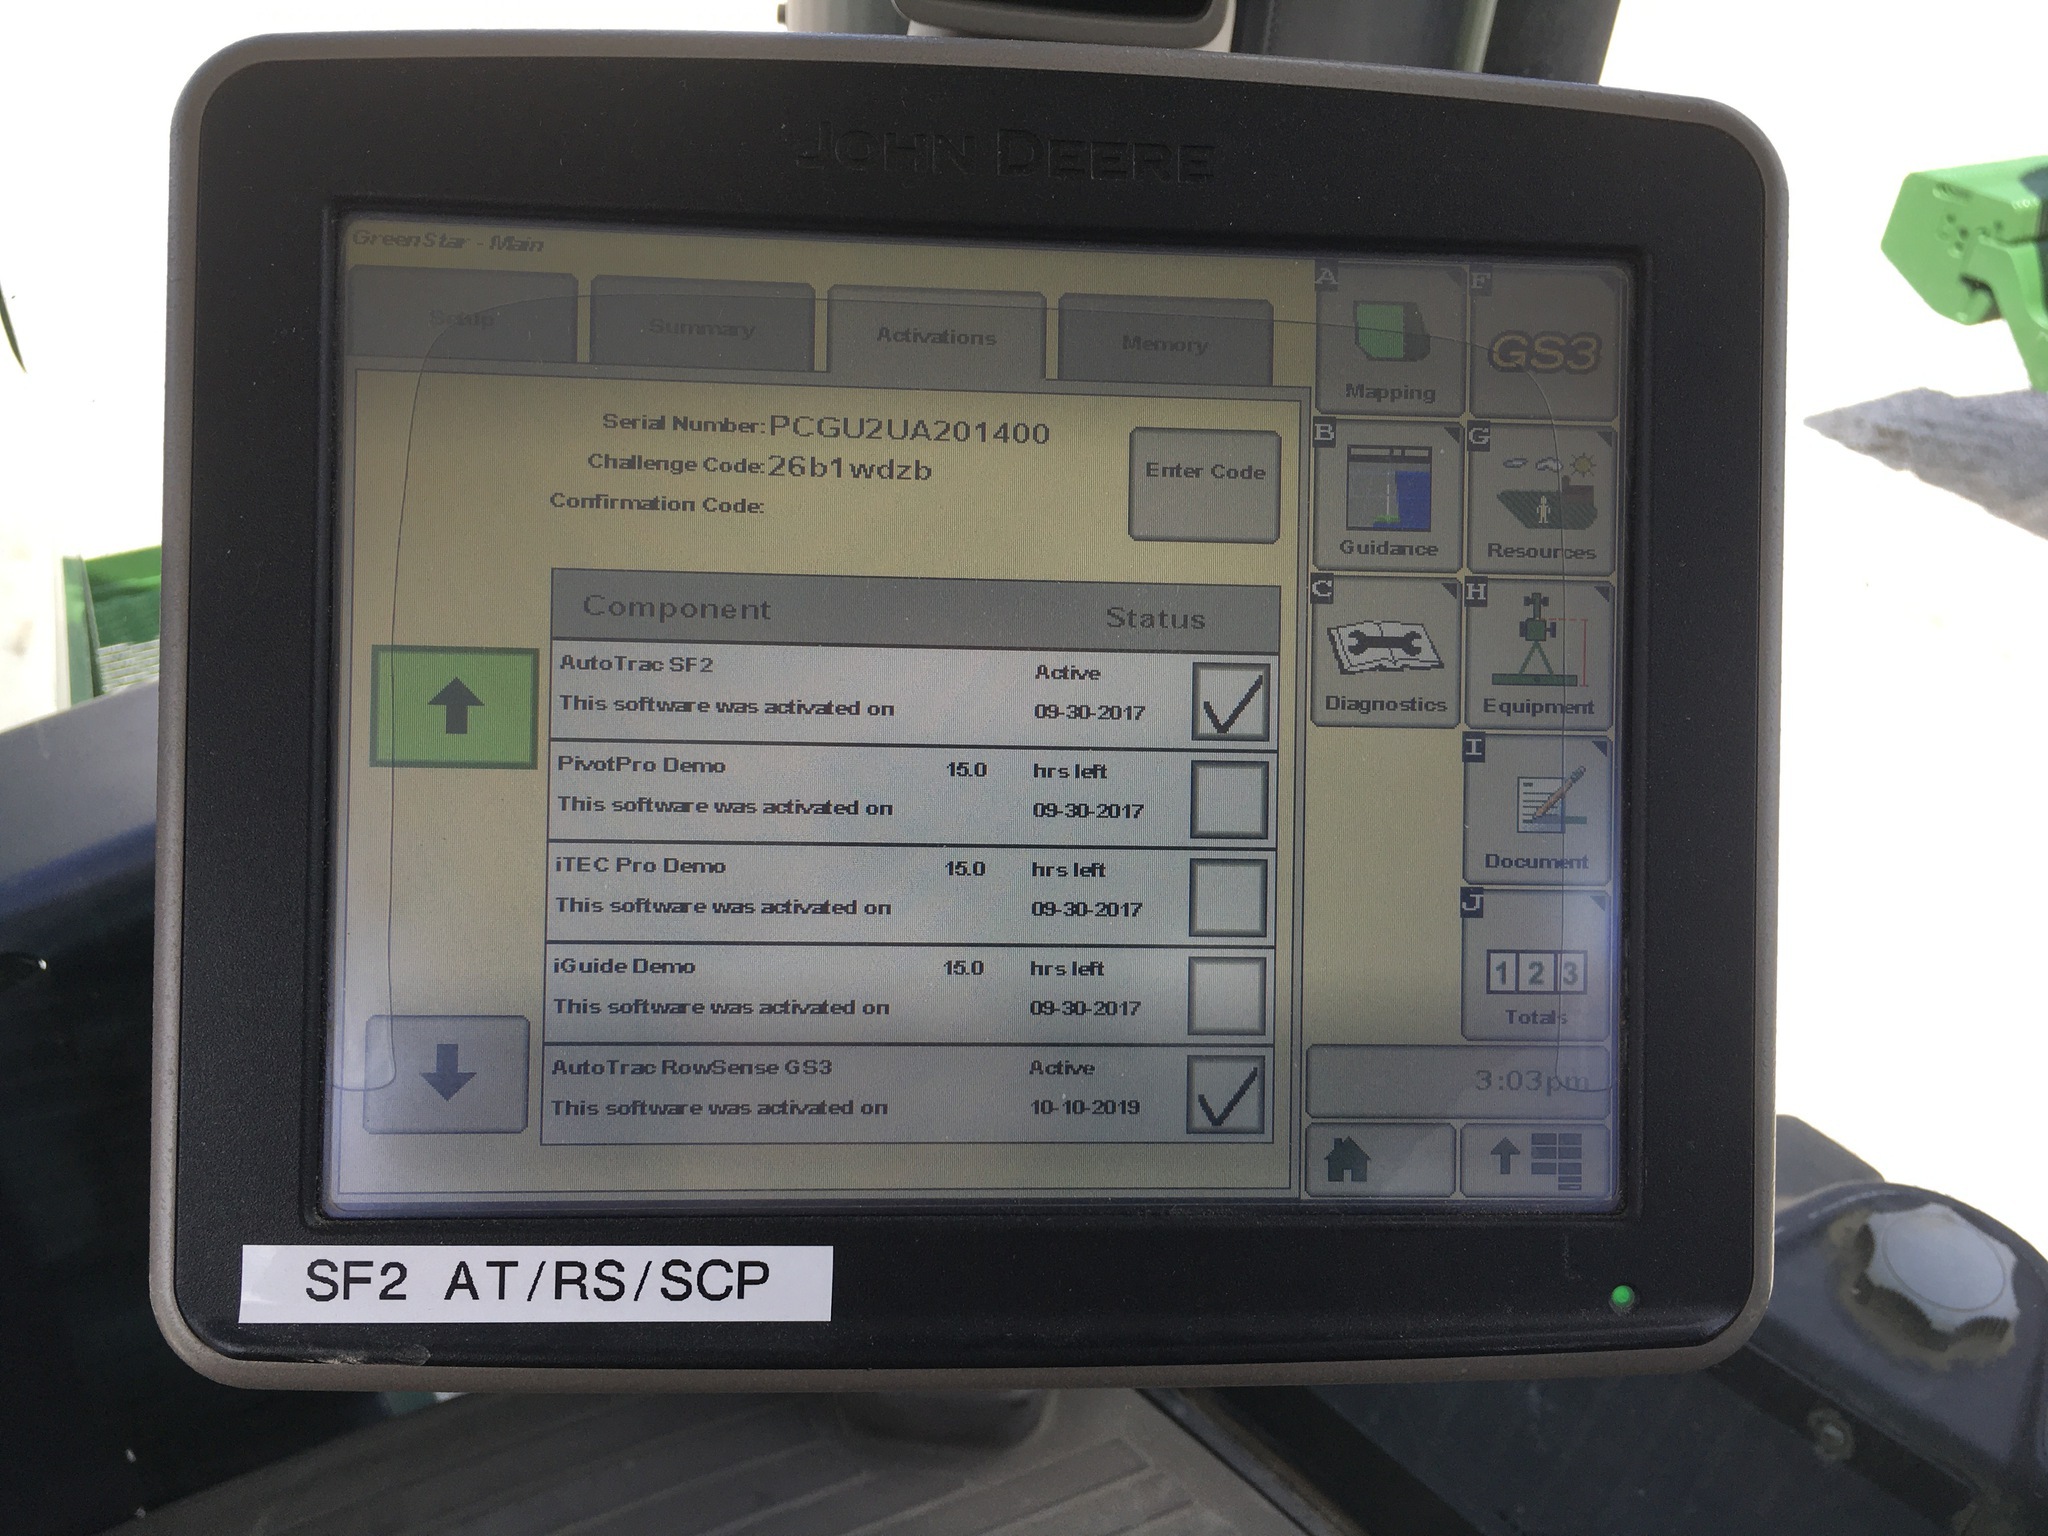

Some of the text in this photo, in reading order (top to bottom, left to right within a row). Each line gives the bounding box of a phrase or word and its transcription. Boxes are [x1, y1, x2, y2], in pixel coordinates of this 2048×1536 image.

[996, 130, 1216, 183] DEERE
[353, 230, 470, 249] GreenStar
[489, 236, 544, 252] Main
[1316, 268, 1338, 284] A
[1472, 272, 1491, 289] F
[429, 310, 495, 329] Setup
[650, 319, 757, 340] Summary
[877, 327, 998, 346] Activations
[1122, 335, 1211, 356] Memory
[1488, 330, 1602, 374] GS3
[1345, 383, 1436, 403] Mapping
[603, 413, 1051, 445] Serial Number: PCGU2UA201400
[1314, 423, 1335, 441] B
[1469, 427, 1491, 445] G
[588, 454, 697, 474] Challenge
[703, 457, 765, 474] Code:
[1146, 461, 1267, 480] Enter Code
[550, 492, 765, 514] Confirmation Code:
[1340, 539, 1439, 557] Guidance
[1487, 543, 1597, 560] Resources
[1312, 580, 1333, 598] C
[1466, 583, 1486, 600] H
[583, 594, 772, 623] Component
[1106, 606, 1206, 630] Status
[560, 654, 714, 672] AutoTrac SF2
[1035, 664, 1101, 681] Active
[560, 695, 895, 716] This software was activated on
[1034, 704, 1146, 721] 09-30-2017
[1325, 695, 1447, 714] Diagnostics
[1483, 698, 1595, 717] Equipment
[558, 756, 726, 773] PivotPro Demo
[947, 762, 988, 778] 15.0
[1033, 763, 1108, 779] hrs left
[558, 796, 893, 816] This software was activated on
[1033, 803, 1144, 819] 09-30-2017
[556, 857, 726, 873] iTEC Pro Demo
[945, 861, 986, 876] 15.0
[1032, 862, 1106, 877] hrs left
[1485, 854, 1589, 869] Document
[556, 897, 892, 915] This software was activated on
[1032, 902, 1143, 917] 09-30-2017
[554, 958, 696, 974] iGuide Demo
[943, 960, 984, 975] 15.0
[1030, 961, 1105, 976] hrs left
[554, 998, 890, 1015] This software was activated on
[1030, 1001, 1141, 1016] 09-30-2017
[1505, 1009, 1568, 1025] Totals
[552, 1059, 832, 1075] AutoTrac RowSense GS3
[1029, 1060, 1096, 1076] Active
[1475, 1070, 1589, 1096] 3:03pm
[552, 1100, 888, 1116] This software was activated on
[1030, 1099, 1140, 1115] 10-10-2019
[306, 1259, 770, 1304] SF2 AT/RS/SCP
